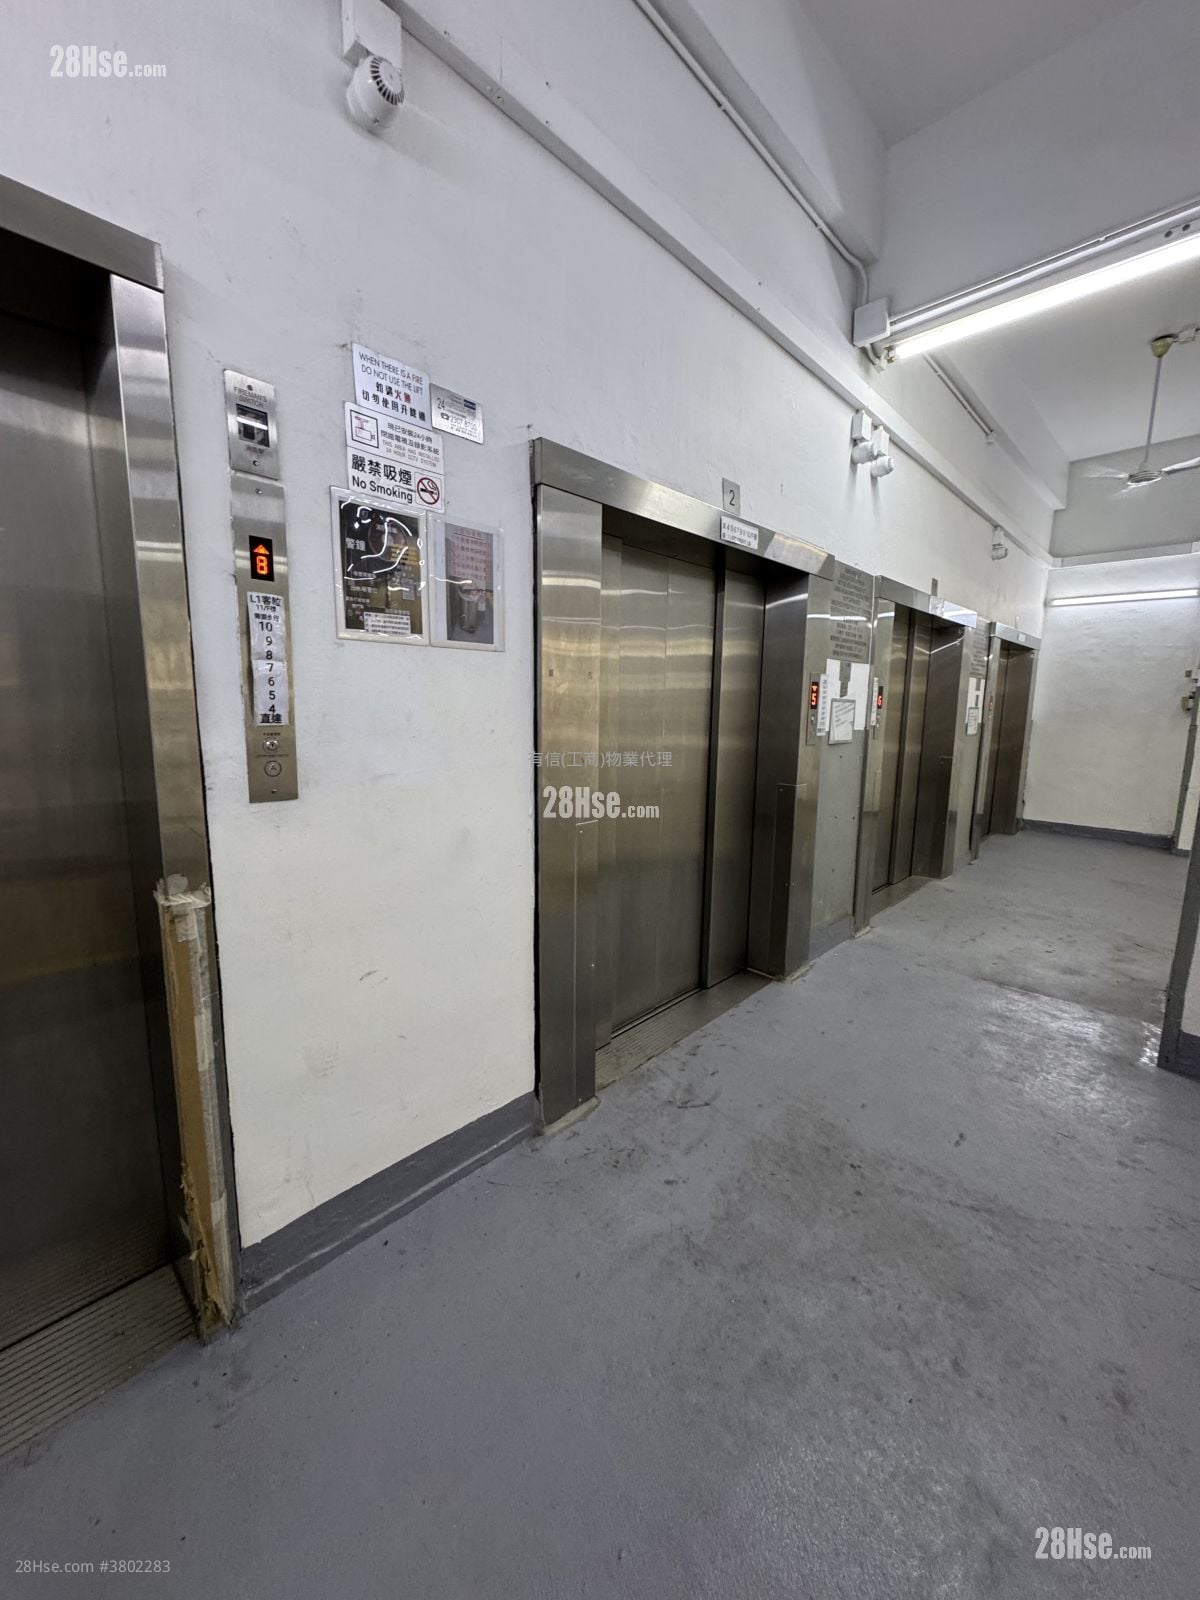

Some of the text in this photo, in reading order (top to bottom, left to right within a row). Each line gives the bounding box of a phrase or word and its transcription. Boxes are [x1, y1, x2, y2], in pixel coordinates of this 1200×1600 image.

[359, 352, 423, 385] WHEN THERE IS A FIRE
[361, 364, 423, 395] DO NOT USE THE LIFT
[437, 397, 445, 410] 24
[352, 453, 412, 487] 嚴禁吸煙
[352, 475, 413, 504] No Smoking
[729, 489, 735, 506] 2
[256, 555, 268, 575] 8
[259, 622, 273, 632] 10
[266, 636, 273, 646] 9
[266, 650, 273, 660] 8
[267, 663, 274, 672] 7
[268, 677, 275, 687] 6
[269, 690, 276, 700] 5
[268, 704, 276, 713] 4
[260, 713, 282, 723] 直達
